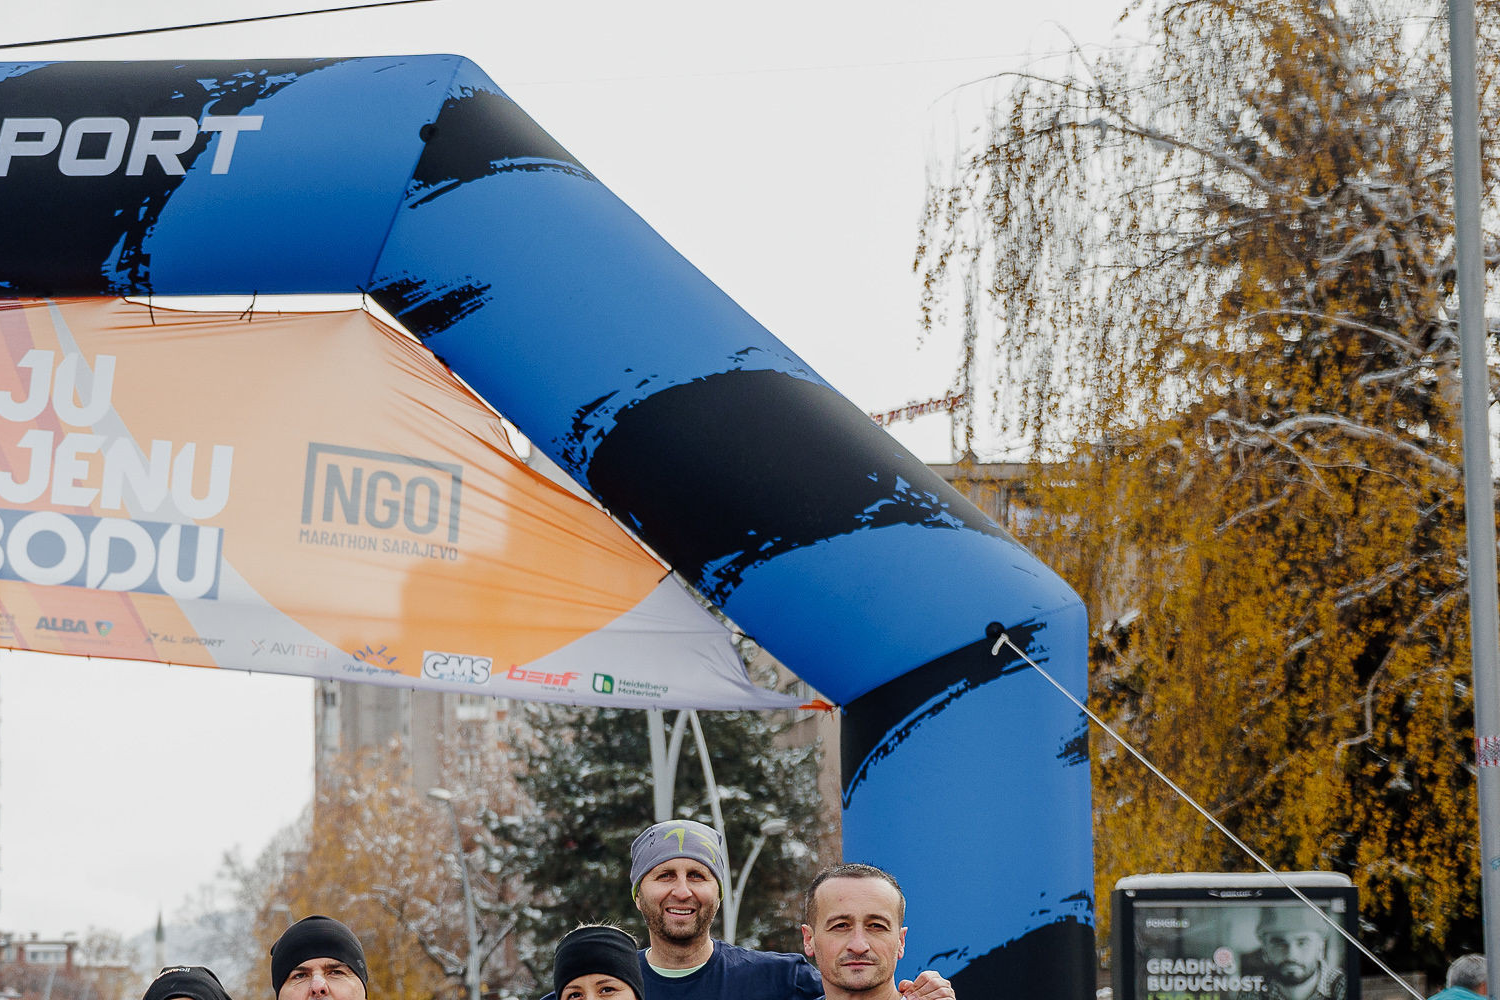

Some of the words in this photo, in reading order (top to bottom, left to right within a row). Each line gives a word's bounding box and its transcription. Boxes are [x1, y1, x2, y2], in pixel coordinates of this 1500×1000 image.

[323, 462, 441, 537] NGO
[299, 528, 379, 554] MARATHON
[381, 535, 459, 562] SARAJEVO
[35, 616, 90, 635] ALBA
[161, 634, 177, 645] AL
[181, 635, 225, 649] SPORT
[270, 642, 328, 661] AVITEH
[424, 653, 492, 684] GMS
[618, 687, 662, 699] Materials
[619, 679, 669, 693] Heidelberg
[1146, 957, 1237, 976] GRADIMO
